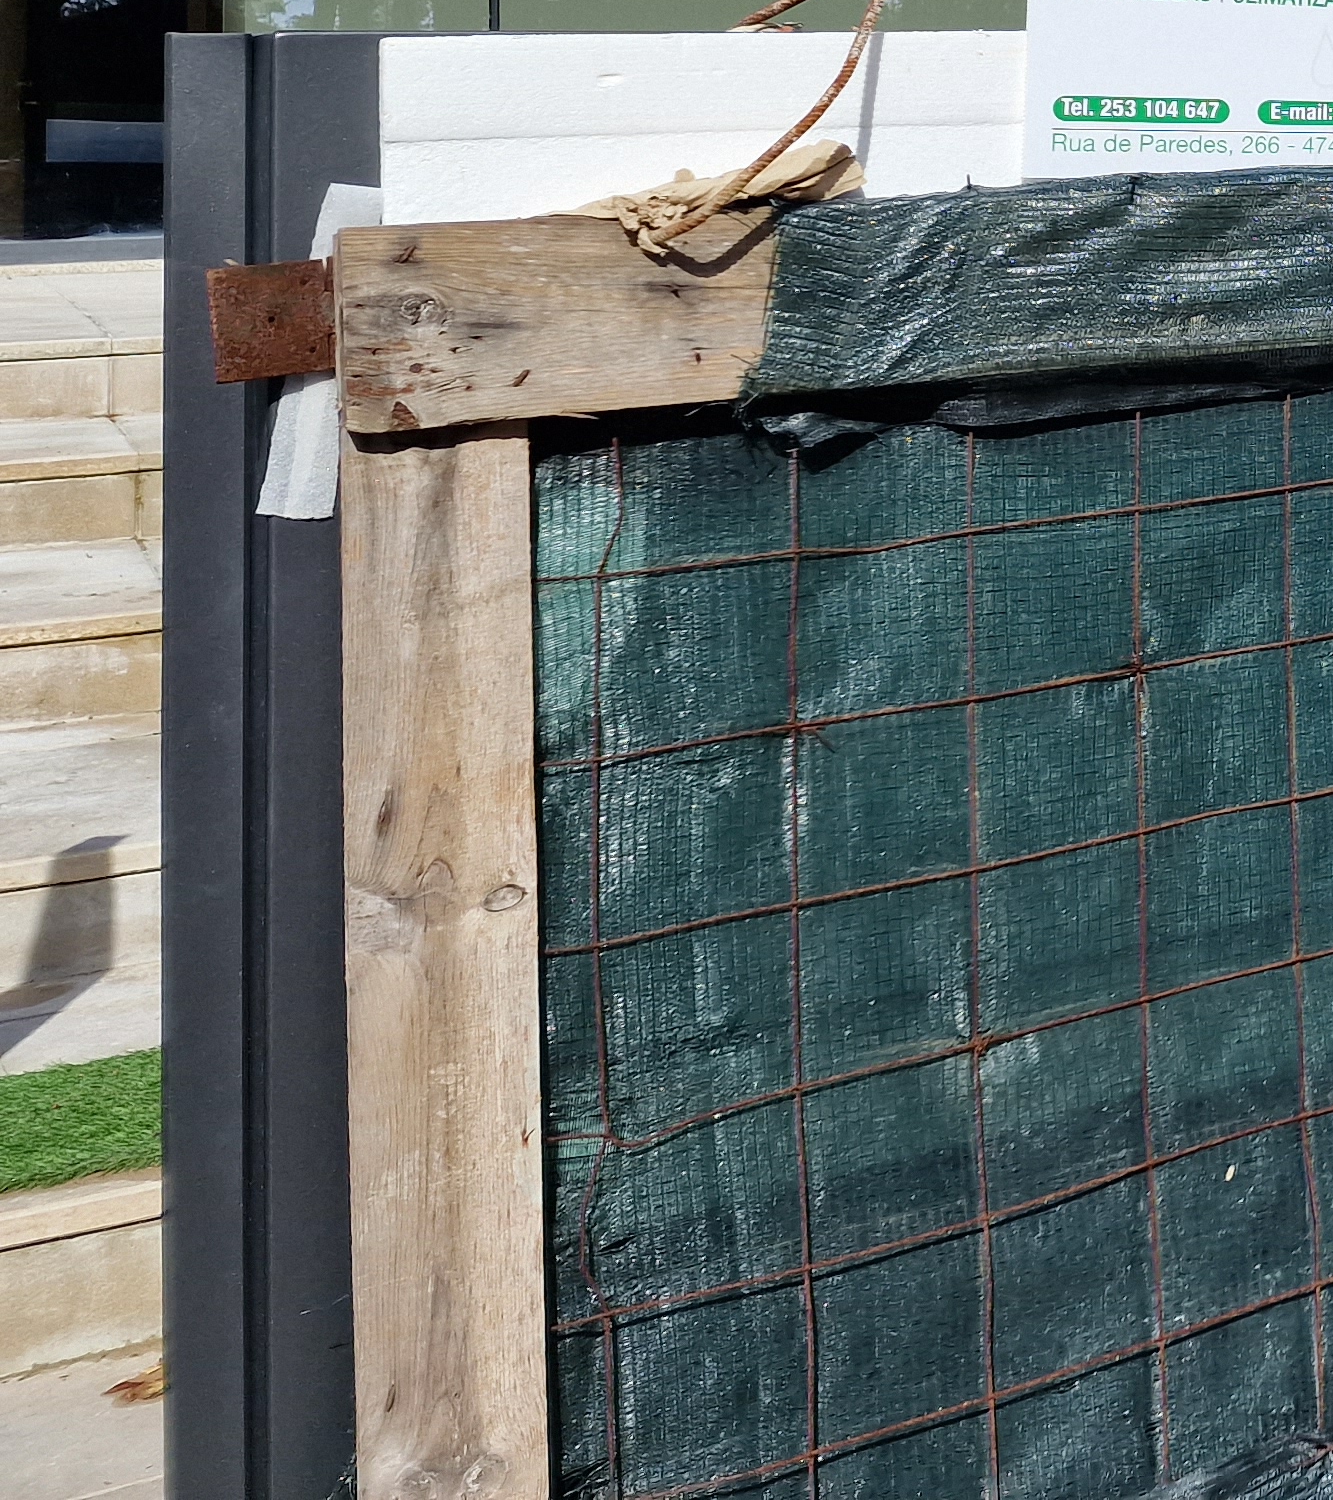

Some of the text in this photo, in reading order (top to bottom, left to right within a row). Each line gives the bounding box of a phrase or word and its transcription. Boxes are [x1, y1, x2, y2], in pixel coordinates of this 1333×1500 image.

[1061, 98, 1219, 119] Tel. 253 104 647
[1271, 103, 1332, 120] E-mail:
[1052, 133, 1095, 152] Rua
[1104, 134, 1131, 152] de
[1140, 134, 1232, 155] Paredes,
[1242, 136, 1279, 153] 266
